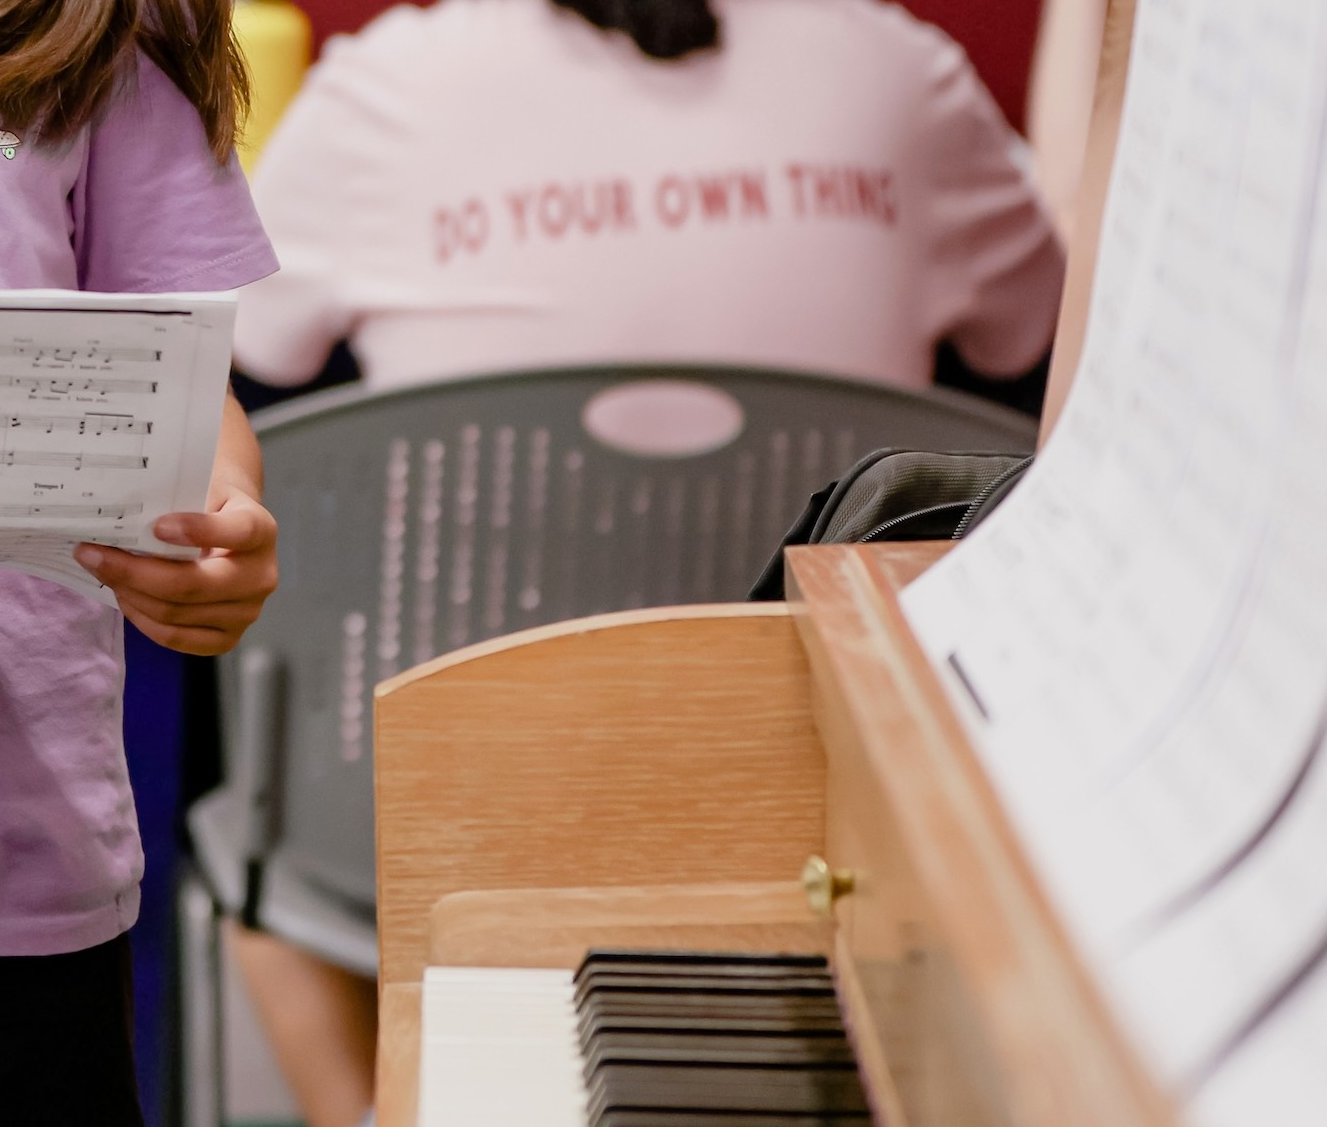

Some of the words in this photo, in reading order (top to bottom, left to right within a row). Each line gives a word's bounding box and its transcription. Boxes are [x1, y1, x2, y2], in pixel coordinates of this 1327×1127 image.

[434, 197, 489, 265] DO
[504, 177, 637, 242] YOUR
[655, 169, 769, 229] OWN
